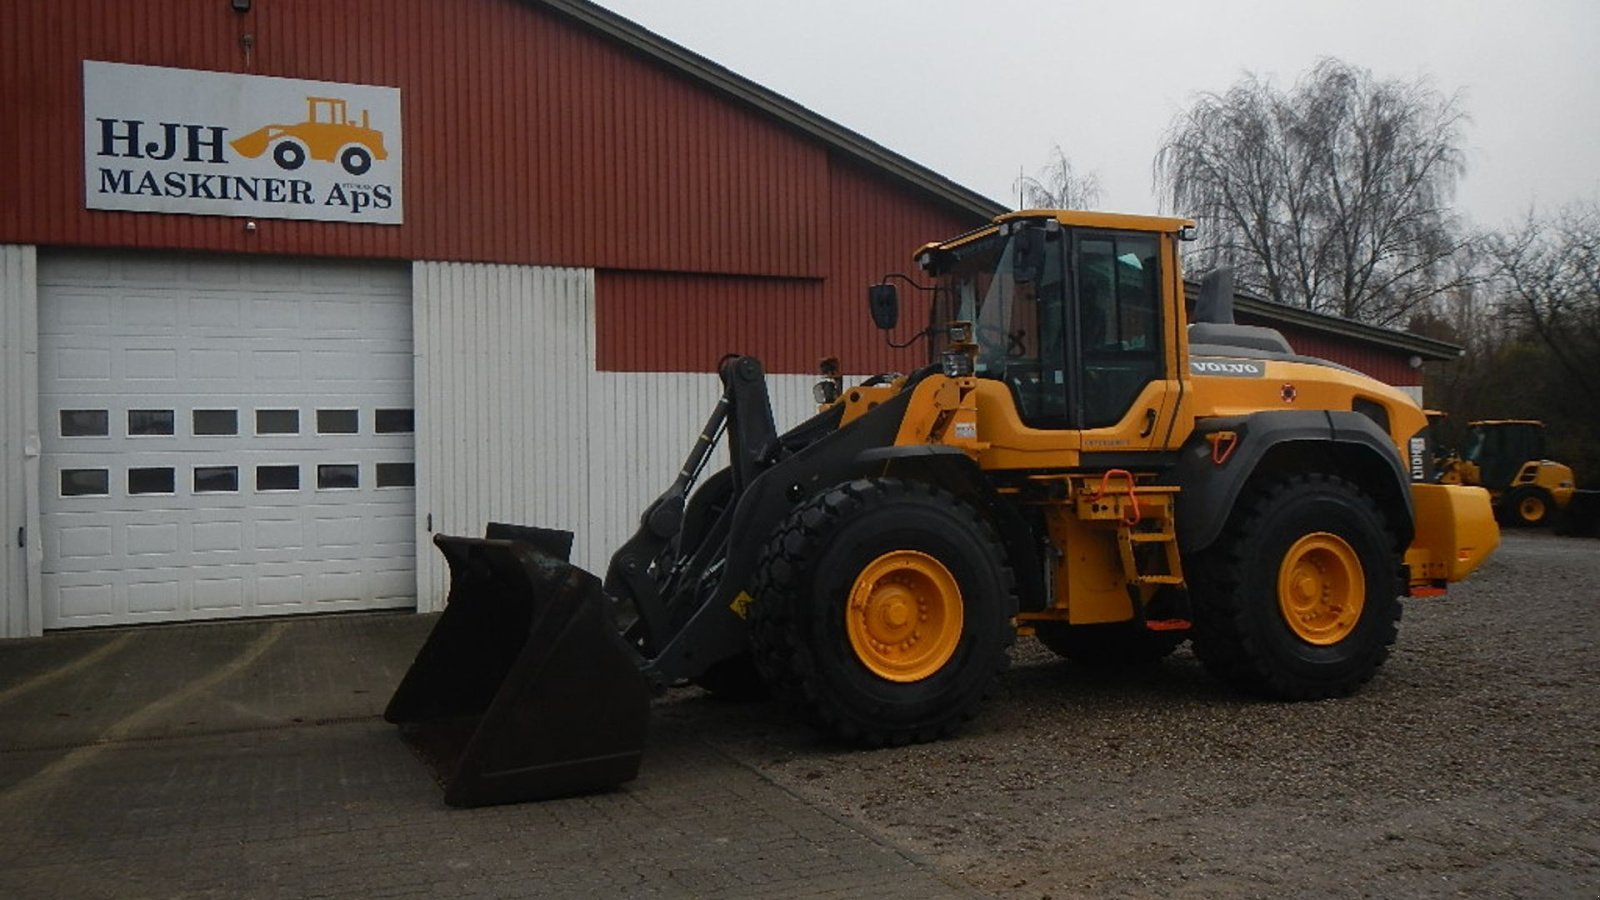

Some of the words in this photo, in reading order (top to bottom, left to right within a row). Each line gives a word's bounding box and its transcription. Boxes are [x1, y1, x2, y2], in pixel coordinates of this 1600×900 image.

[96, 117, 229, 164] HJH
[98, 167, 315, 204] MASKINER
[324, 182, 392, 213] ApS
[1191, 362, 1259, 373] VOLVO
